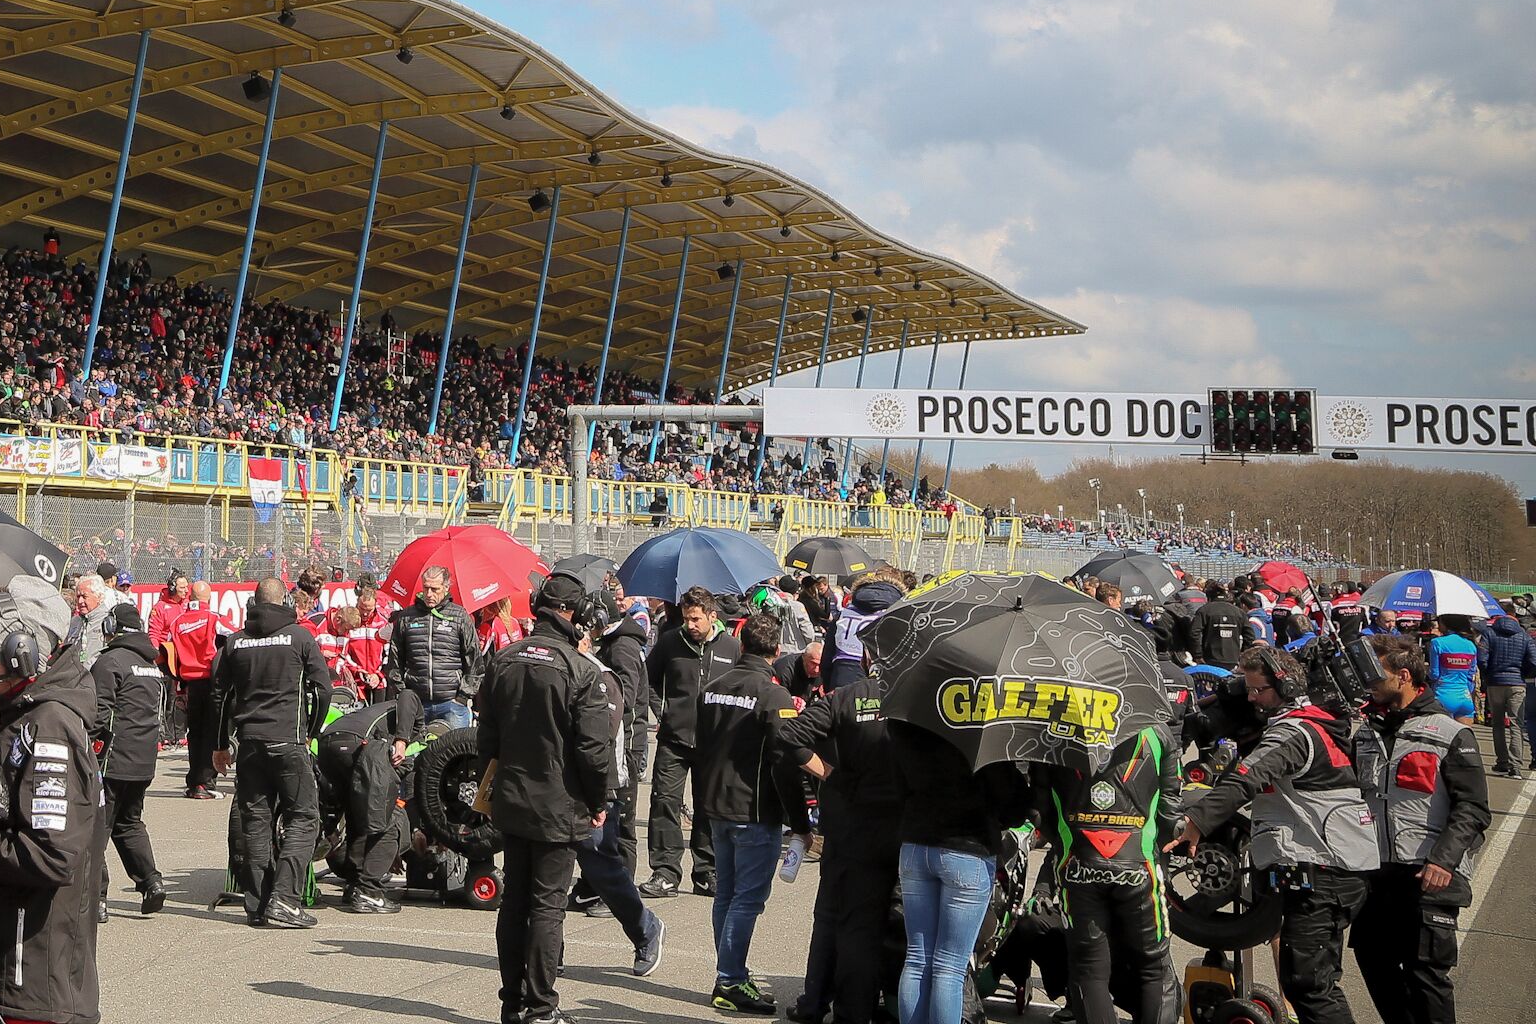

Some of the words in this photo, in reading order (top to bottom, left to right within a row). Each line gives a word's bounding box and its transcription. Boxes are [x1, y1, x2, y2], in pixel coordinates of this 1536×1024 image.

[917, 395, 1112, 437] PROSECCO
[1126, 398, 1202, 439] DOC
[177, 453, 187, 478] H
[233, 634, 292, 650] Kawasaki
[703, 691, 758, 710] Kawasaki
[941, 680, 1120, 731] GALFER
[1076, 812, 1108, 823] BEAT
[1108, 814, 1146, 828] BIKERS
